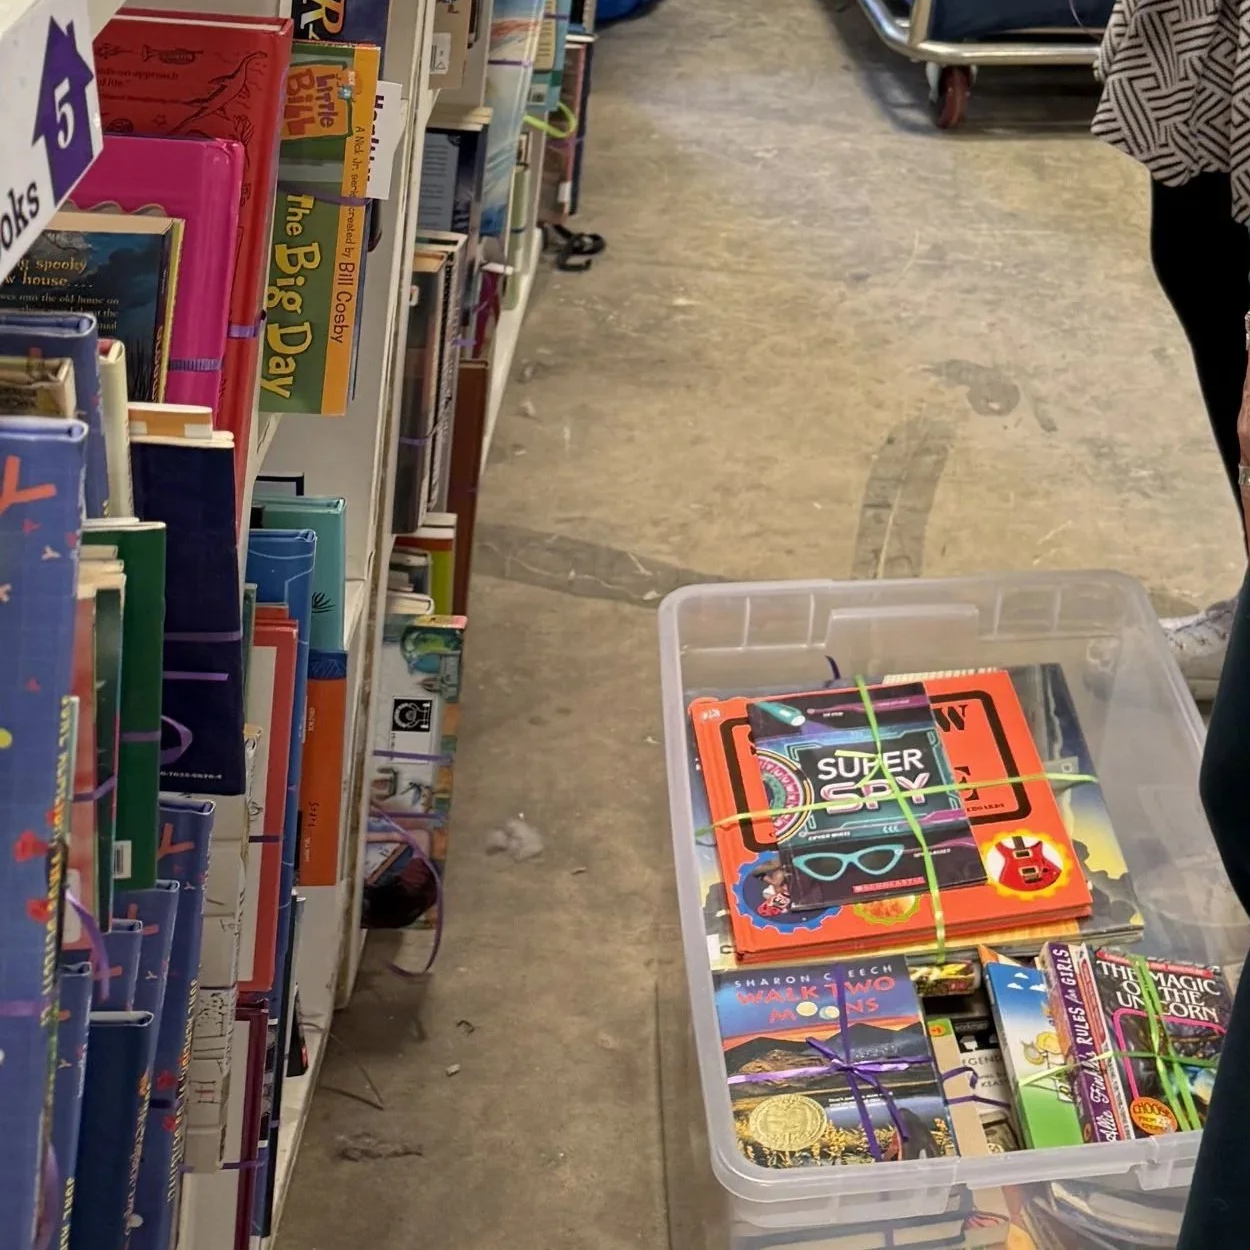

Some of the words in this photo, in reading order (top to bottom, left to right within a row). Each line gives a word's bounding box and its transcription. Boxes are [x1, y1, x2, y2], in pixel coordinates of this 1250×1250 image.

[54, 77, 75, 149] 5
[354, 135, 364, 153] Nick
[352, 157, 364, 173] Jr.
[286, 194, 317, 237] The
[36, 256, 87, 274] spooky
[343, 246, 355, 259] by
[266, 241, 322, 315] Big
[337, 262, 355, 286] Bill
[331, 289, 353, 344] Cosby
[260, 321, 313, 399] Day
[817, 748, 924, 780] SUPER
[820, 772, 930, 815] SPY
[735, 975, 811, 988] SHARON
[823, 964, 893, 981] CEECH
[1052, 948, 1077, 991] GIRLS
[1096, 960, 1139, 981] THE
[1149, 972, 1221, 996] MAGIC
[736, 985, 819, 1005] WALK
[824, 976, 896, 997] TWO
[1064, 988, 1083, 1004] for
[1157, 986, 1205, 1007] THE
[1116, 991, 1220, 1023] UNORN
[1068, 1007, 1094, 1046] RULES
[1096, 1109, 1118, 1143] Allie
